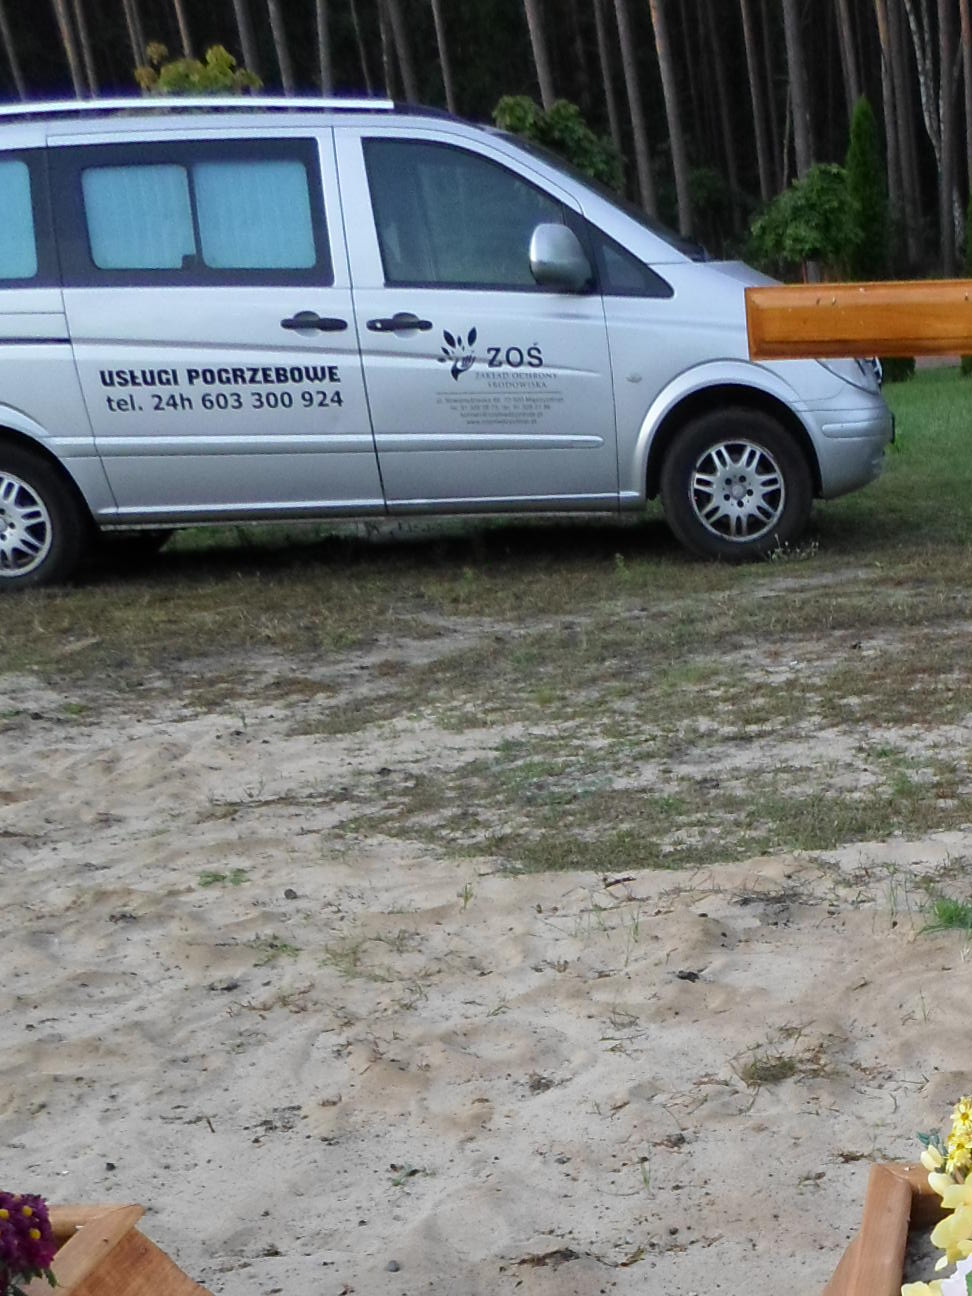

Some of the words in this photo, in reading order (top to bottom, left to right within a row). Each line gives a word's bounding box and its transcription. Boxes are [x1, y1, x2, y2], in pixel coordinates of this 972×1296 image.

[487, 341, 544, 368] ZOŚ
[99, 369, 179, 388] USŁUGI
[186, 365, 342, 386] POGRZEBOWE
[106, 394, 143, 412] tel.
[152, 393, 194, 411] 24h
[201, 392, 243, 410] 603
[251, 391, 293, 409] 300
[301, 390, 344, 408] 924
